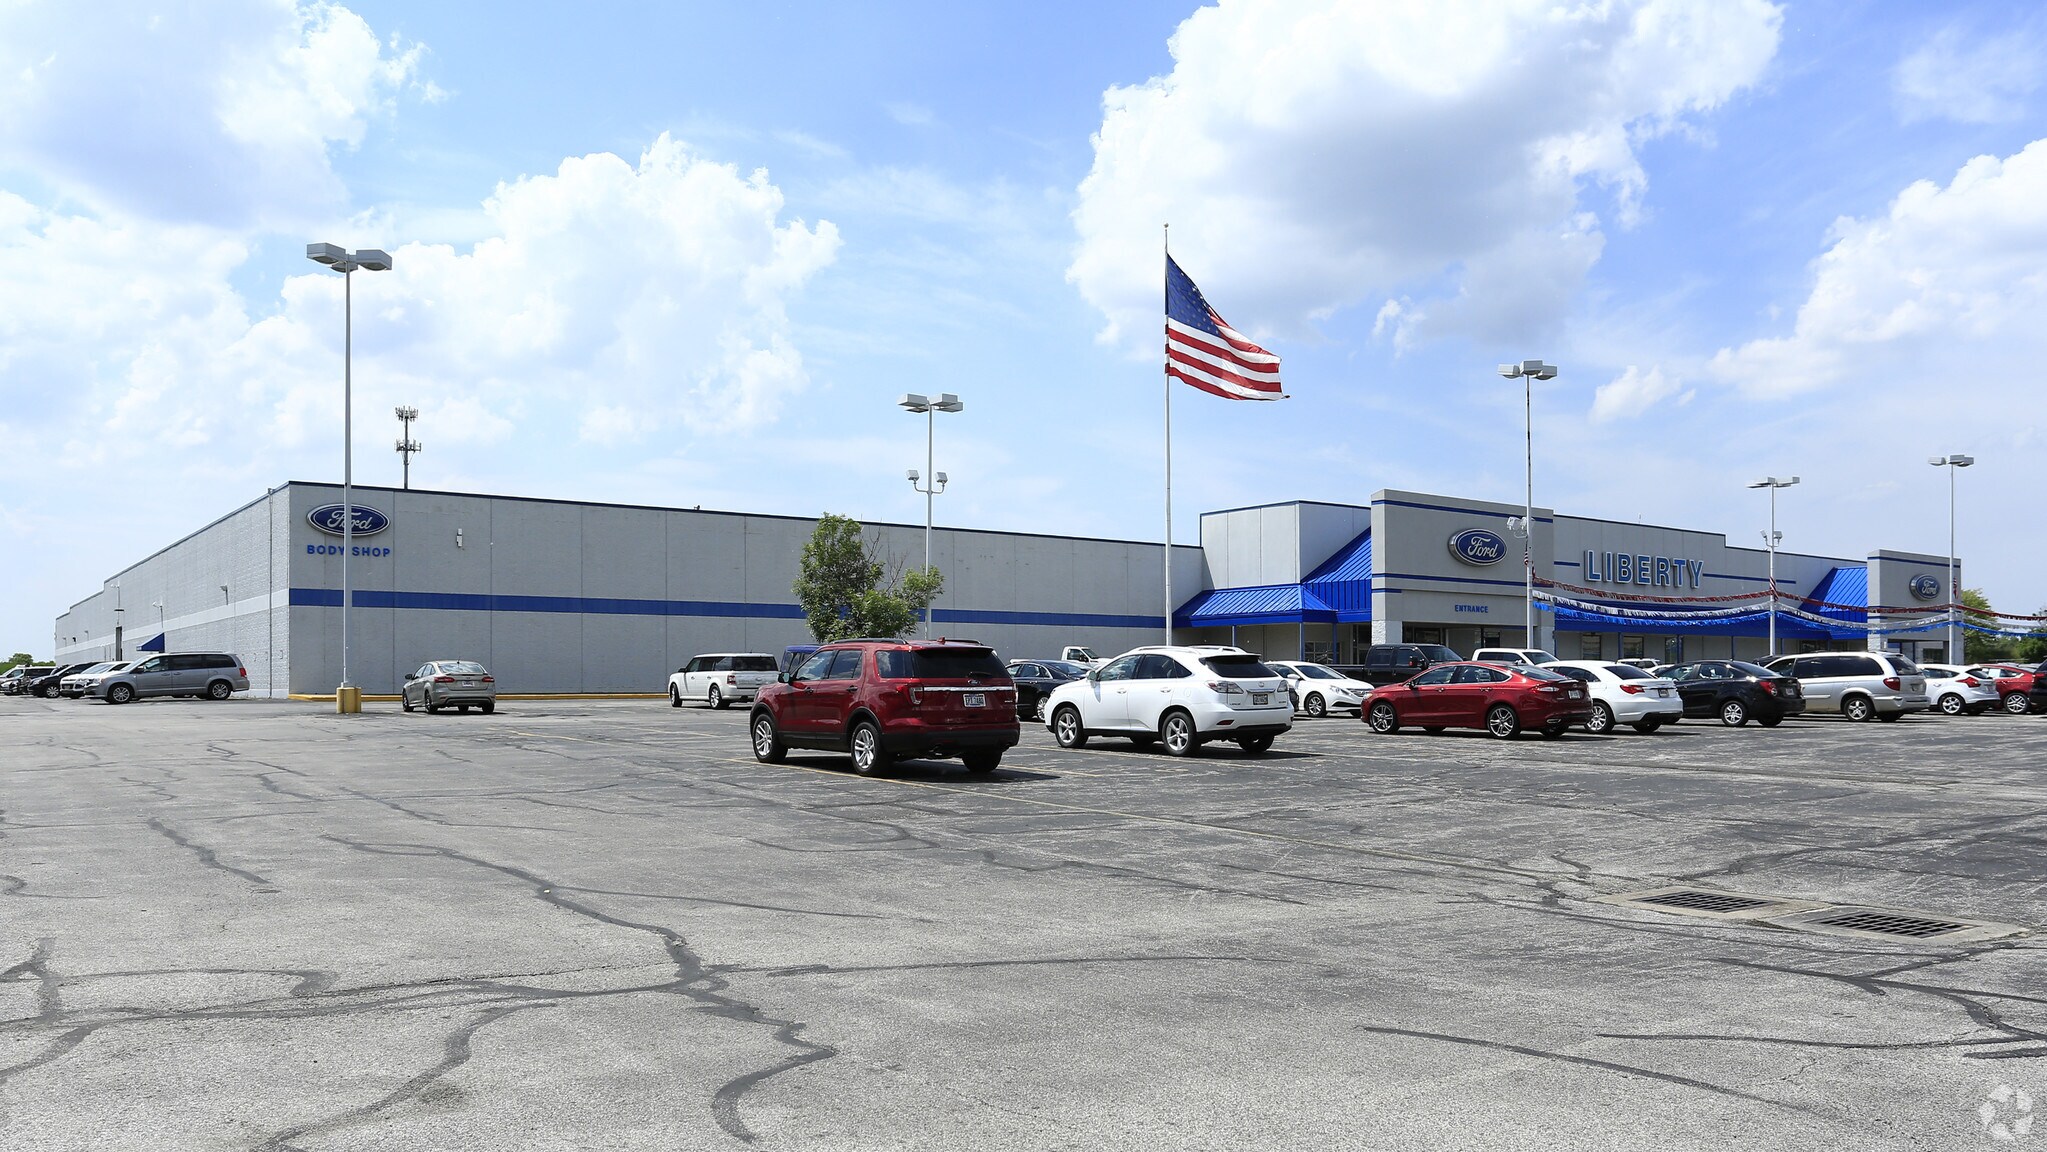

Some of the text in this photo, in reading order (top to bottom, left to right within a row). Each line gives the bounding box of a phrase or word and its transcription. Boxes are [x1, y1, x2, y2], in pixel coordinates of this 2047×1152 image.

[352, 546, 391, 557] SHOP
[1467, 536, 1499, 558] Ford
[1584, 549, 1704, 589] LIBERTY
[1921, 579, 1938, 595] Ford
[1455, 604, 1489, 613] ENTRANCE
